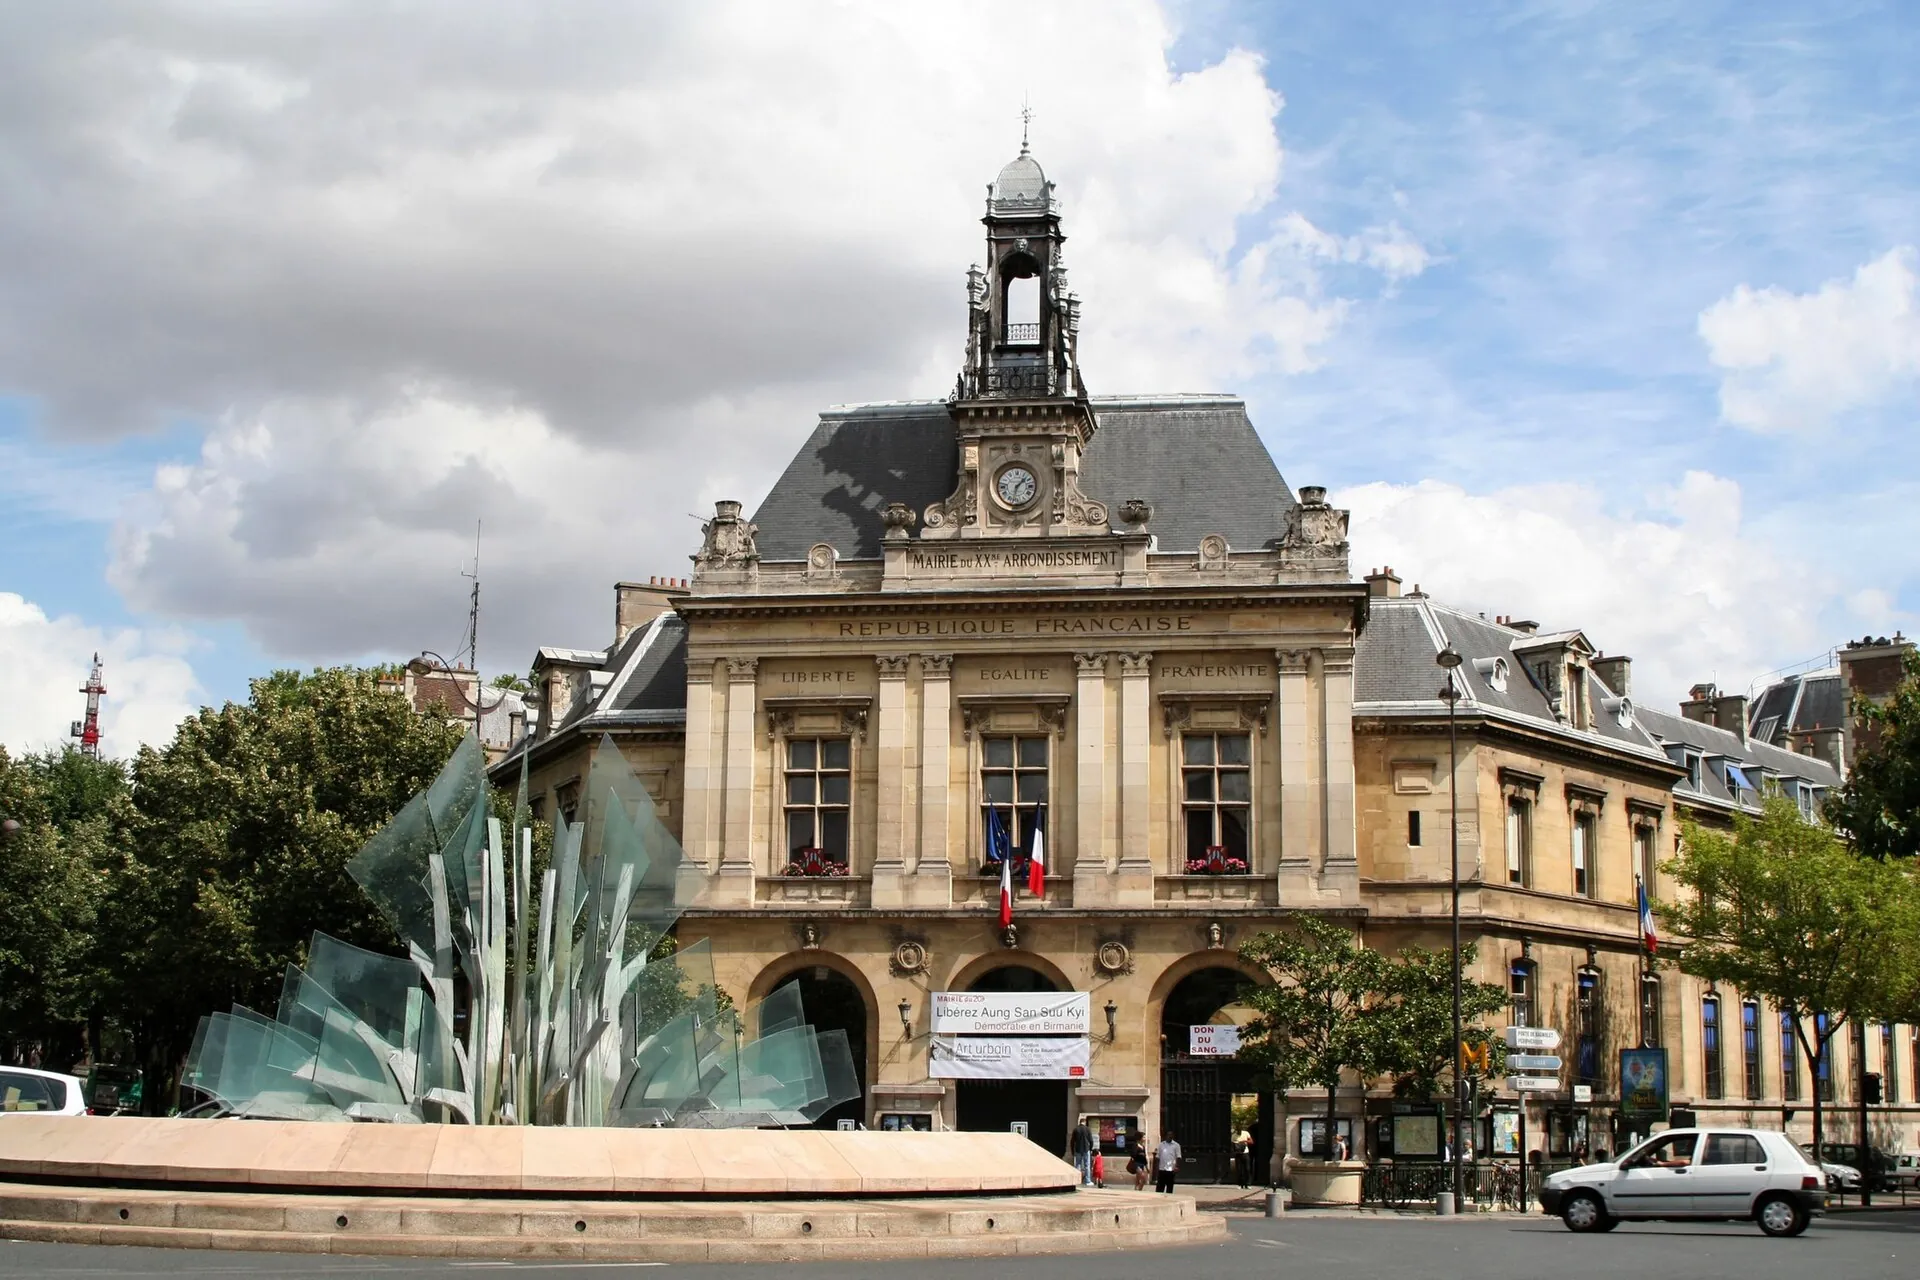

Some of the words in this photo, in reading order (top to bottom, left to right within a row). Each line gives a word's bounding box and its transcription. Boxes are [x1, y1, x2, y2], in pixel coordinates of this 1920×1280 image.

[913, 554, 958, 569] MAIRIE
[960, 559, 972, 568] DU
[1003, 550, 1117, 568] ARRONDISSEMENT
[839, 619, 1015, 636] REPUBLIQUE
[1036, 616, 1193, 632] FRANÇAISE
[782, 671, 856, 682] LIBERTE
[980, 669, 1050, 680] EGALITE
[1161, 665, 1268, 677] FRATERNITE
[936, 1007, 978, 1018] Libérez
[981, 1007, 1010, 1019] Aung
[1014, 1007, 1037, 1018] San
[1040, 1007, 1063, 1018] Suu
[1066, 1007, 1085, 1019] Kyi
[1029, 1023, 1041, 1031] en
[1043, 1021, 1084, 1031] Birmanie
[955, 1042, 972, 1054] Art
[975, 1043, 1012, 1054] urbain
[1461, 1040, 1488, 1071] M
